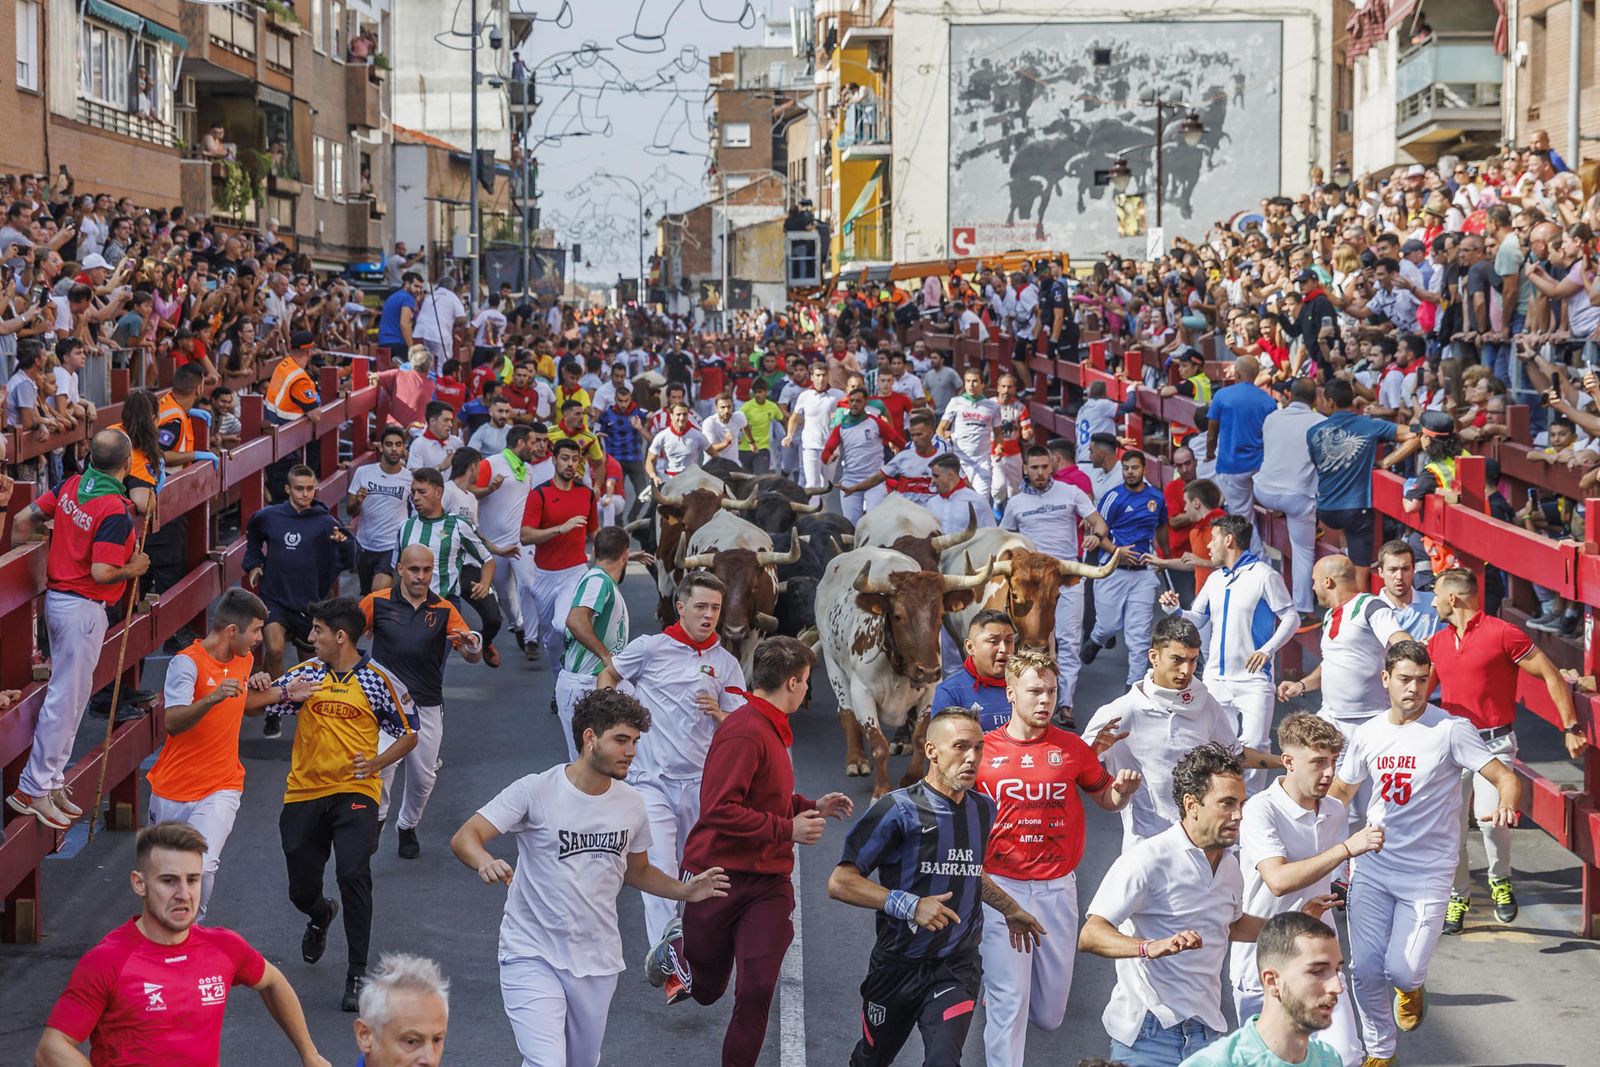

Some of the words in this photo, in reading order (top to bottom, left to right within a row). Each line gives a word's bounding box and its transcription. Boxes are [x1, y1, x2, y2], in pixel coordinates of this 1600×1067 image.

[58, 492, 93, 532] PASTRES
[1377, 756, 1395, 770] LOS
[1380, 772, 1412, 806] 25
[947, 848, 974, 862] BAR
